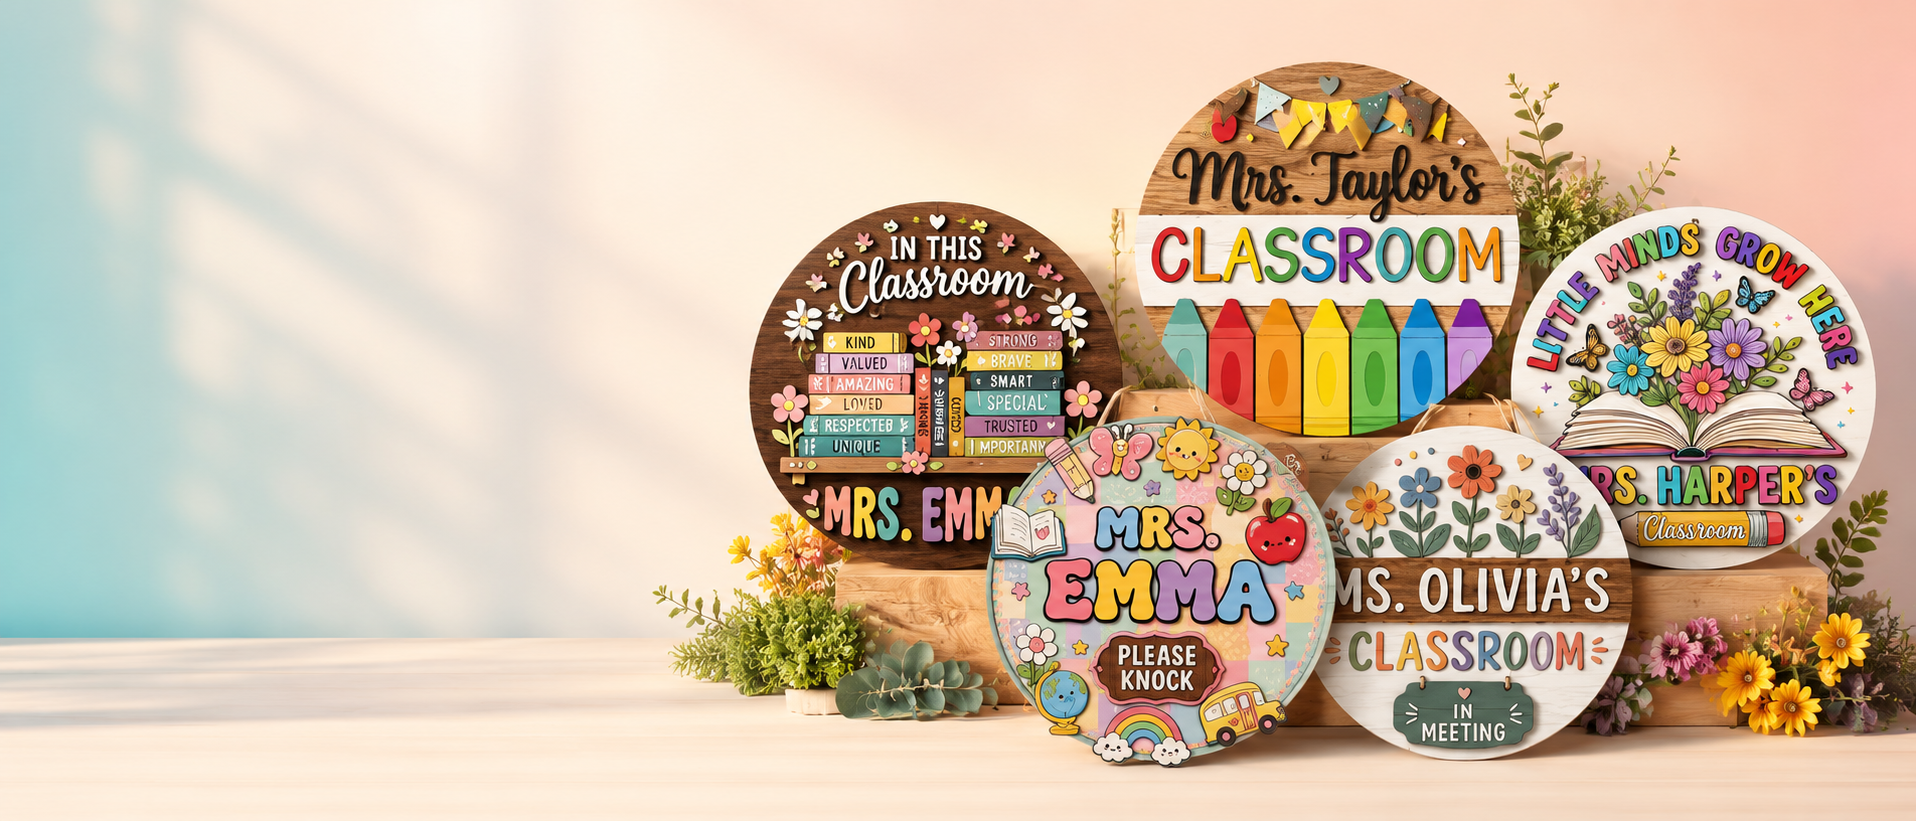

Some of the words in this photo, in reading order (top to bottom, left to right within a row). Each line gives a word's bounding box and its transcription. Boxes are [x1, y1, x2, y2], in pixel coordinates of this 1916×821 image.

[1172, 147, 1301, 212] Mrs.
[1310, 144, 1486, 222] Taylor's
[890, 235, 917, 261] IN
[926, 235, 982, 261] THIS
[1151, 226, 1502, 284] CLASSROOM
[838, 256, 1035, 315] Classroom
[1526, 270, 1600, 372] LITTLE
[1595, 223, 1700, 283] MINDS
[1715, 226, 1810, 290] GROW
[1798, 284, 1859, 369] HERE
[845, 336, 876, 349] KIND
[988, 334, 1038, 347] STRONG
[842, 356, 888, 370] VALUED
[991, 354, 1032, 368] BRAVE
[836, 377, 894, 391] AMAZING
[990, 374, 1033, 388] SMART
[843, 397, 883, 411] LOVED
[984, 420, 1038, 433] TRUSTED
[832, 439, 881, 455] UNIQUE
[1580, 465, 1648, 505] RS.
[1656, 464, 1839, 505] HARPER'S
[824, 485, 913, 542] MRS.
[922, 486, 1020, 542] EMM
[1094, 505, 1221, 550] MRS.
[1643, 515, 1746, 541] Classroom
[1043, 557, 1278, 625] EMMA
[1335, 567, 1405, 613] MS.
[1418, 567, 1610, 613] OLIVIA'S
[1118, 644, 1197, 667] PLEASE
[1348, 631, 1584, 672] CLASSROOM
[1120, 669, 1195, 692] KNOCK
[1453, 703, 1473, 720] IN
[1421, 722, 1506, 743] MEETING
